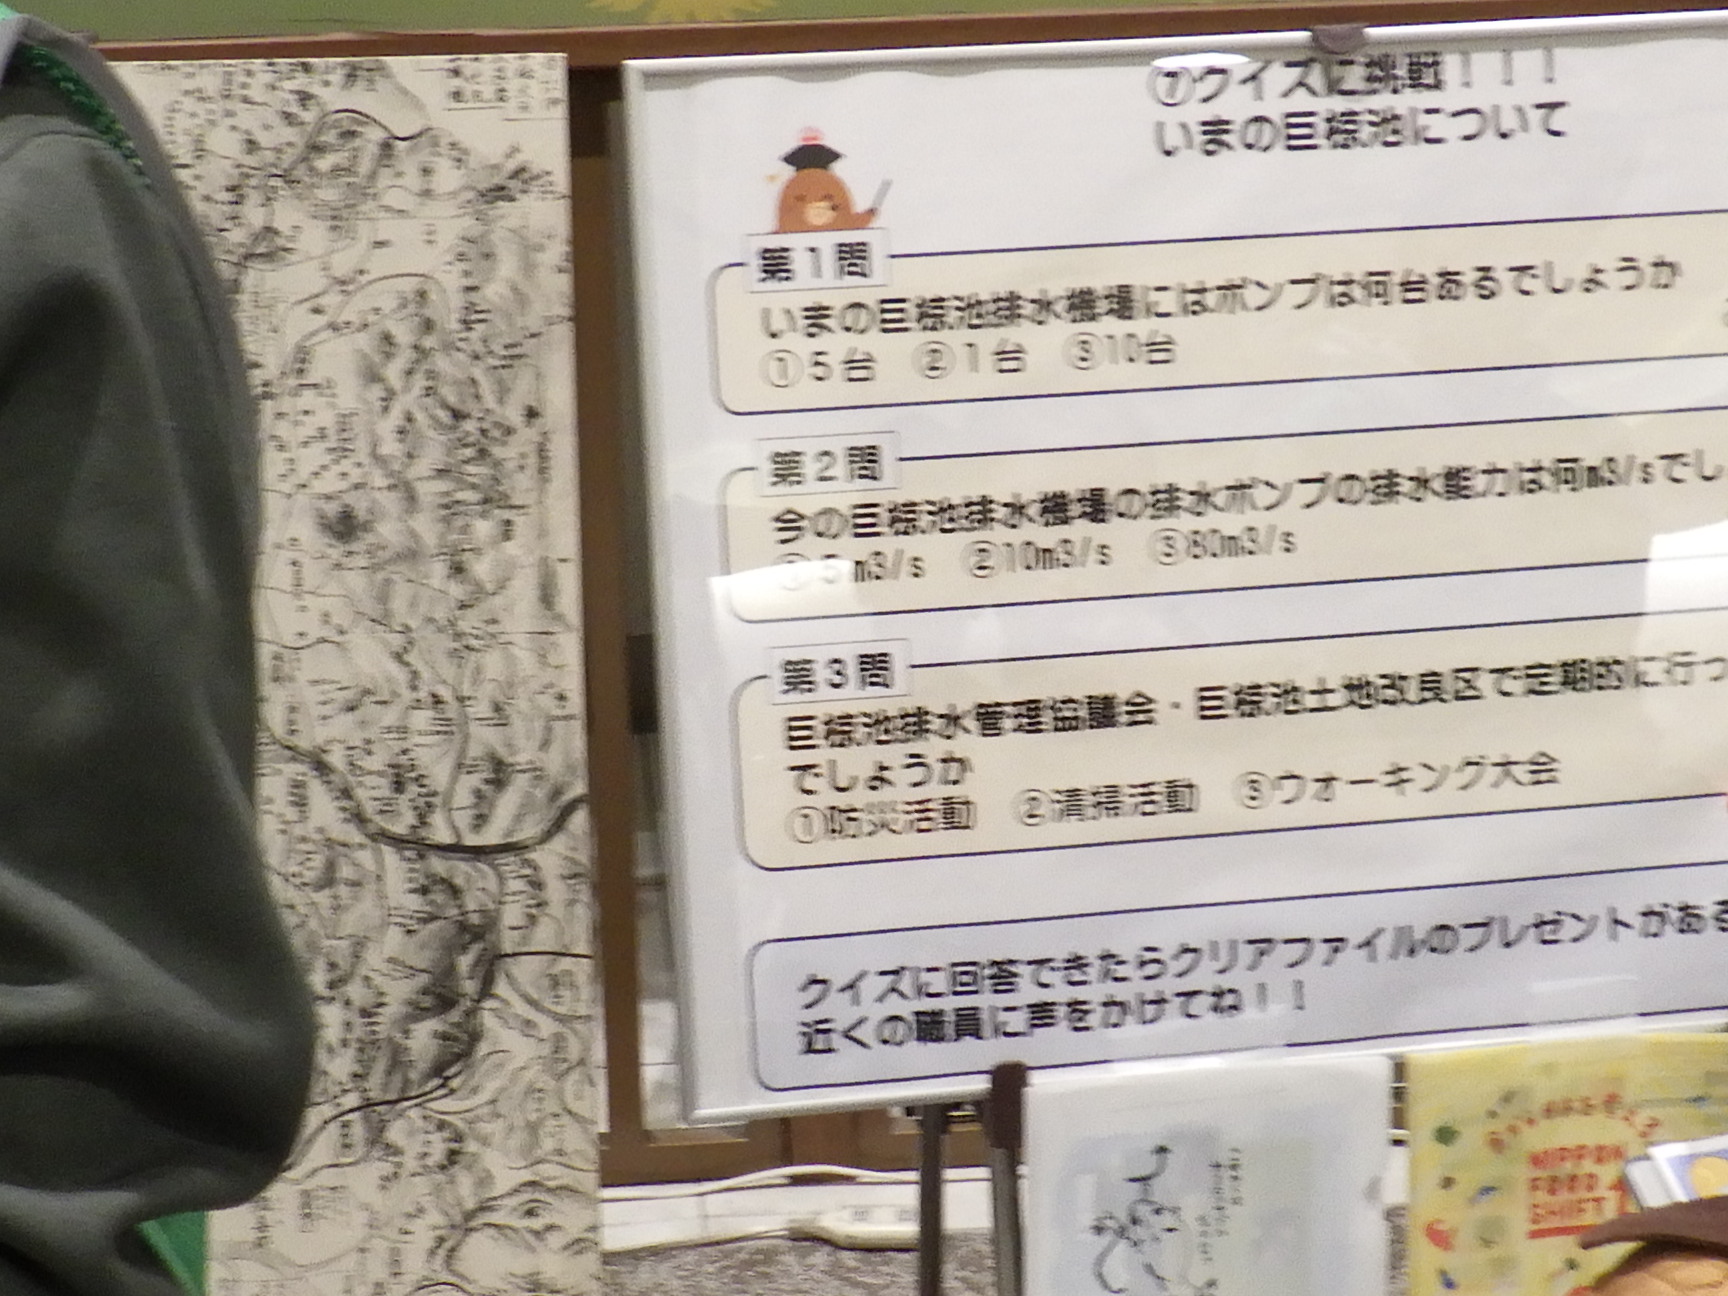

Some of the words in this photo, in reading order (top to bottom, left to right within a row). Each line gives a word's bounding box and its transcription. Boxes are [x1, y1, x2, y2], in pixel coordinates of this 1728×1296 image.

[1153, 100, 1568, 157] いまの巨椋池について
[757, 241, 871, 284] 第1問
[769, 445, 883, 487] 第2問
[781, 652, 894, 695] 第3問
[785, 750, 973, 796] でしょうか
